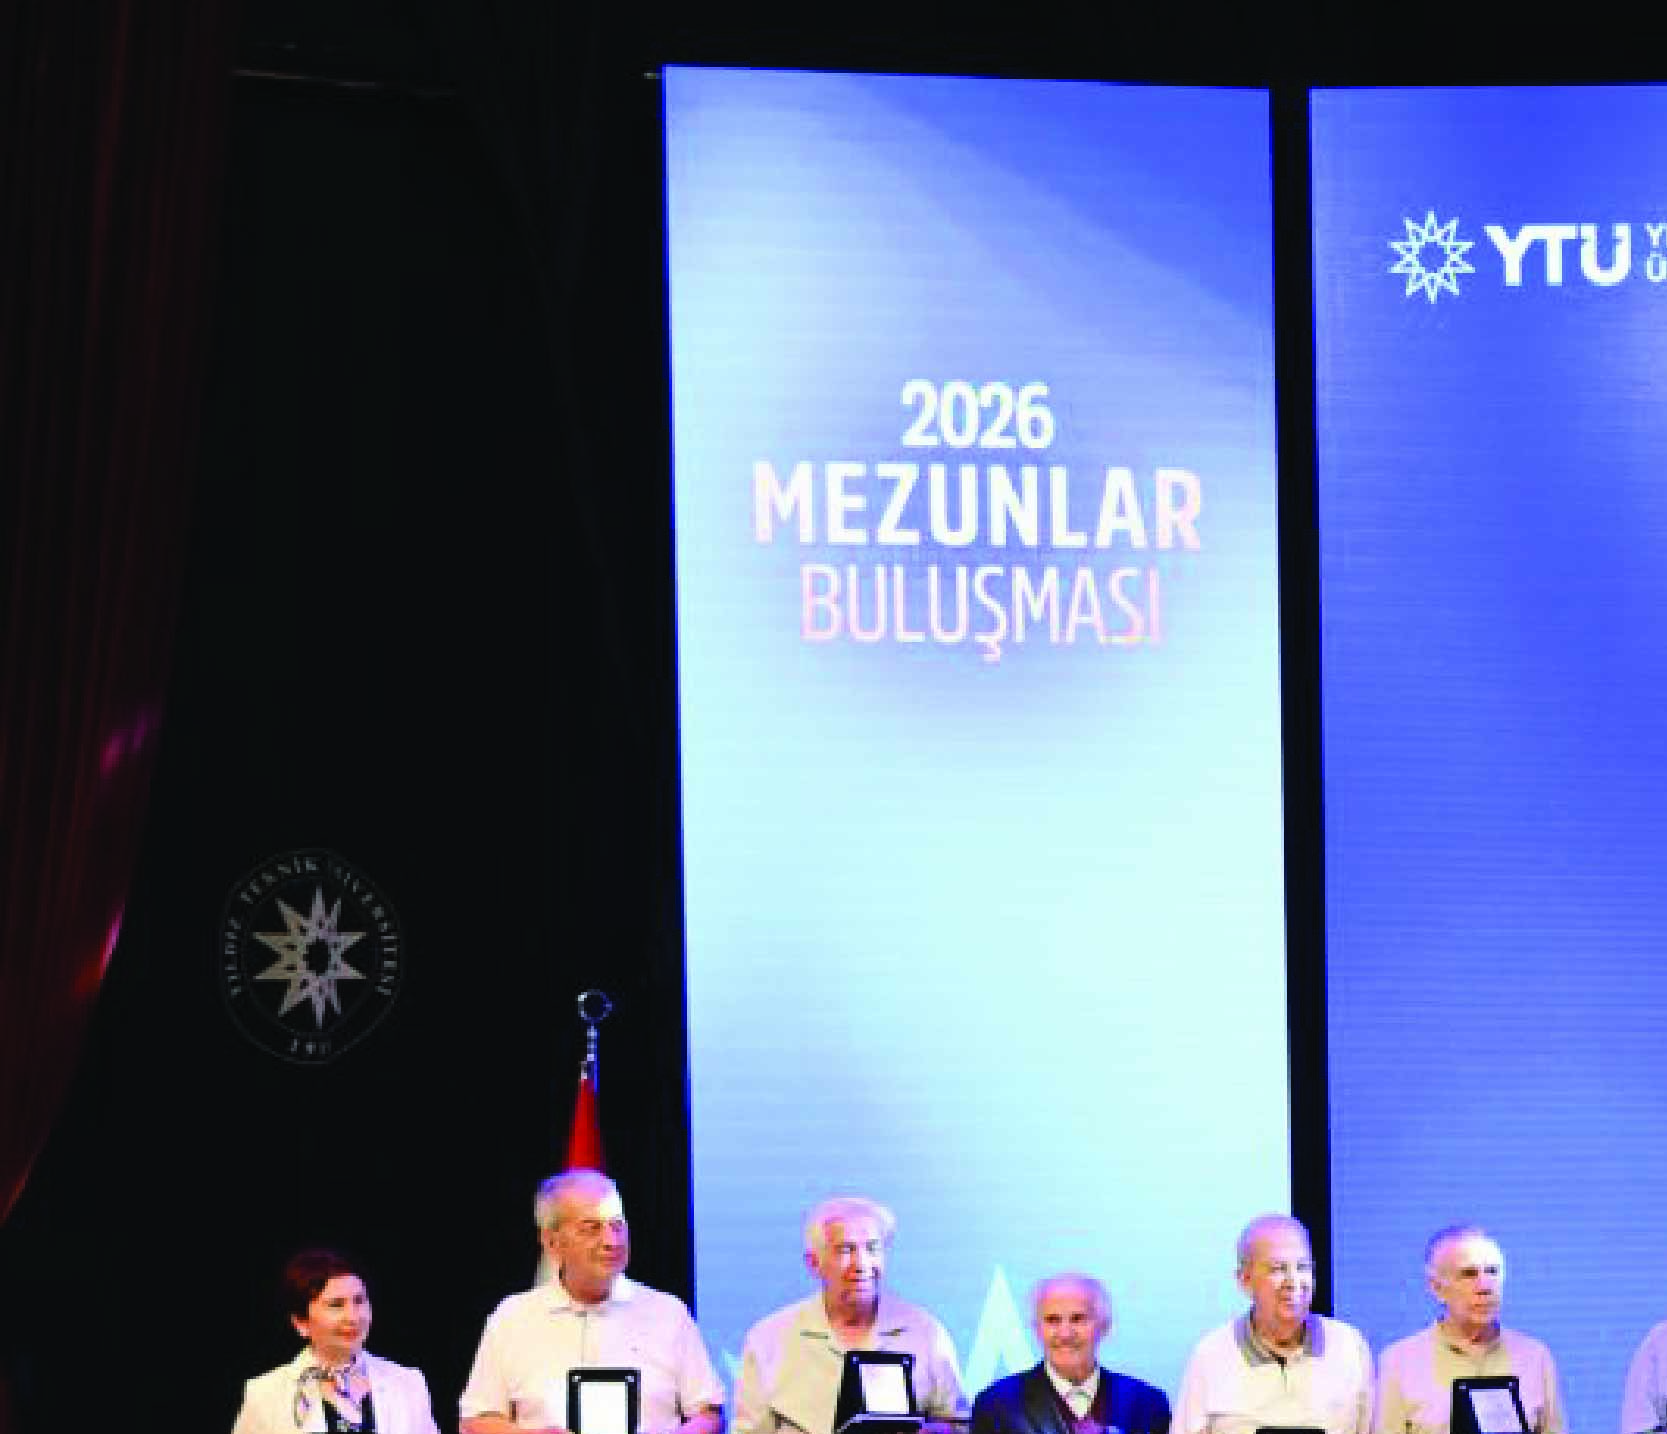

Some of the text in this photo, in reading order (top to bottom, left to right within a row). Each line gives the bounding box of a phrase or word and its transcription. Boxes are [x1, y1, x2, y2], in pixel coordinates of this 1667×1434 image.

[1484, 223, 1632, 286] YTU
[900, 379, 1055, 449] 2026
[752, 461, 1200, 549] MEZUNLAR
[801, 564, 1163, 661] BULUŞMASI
